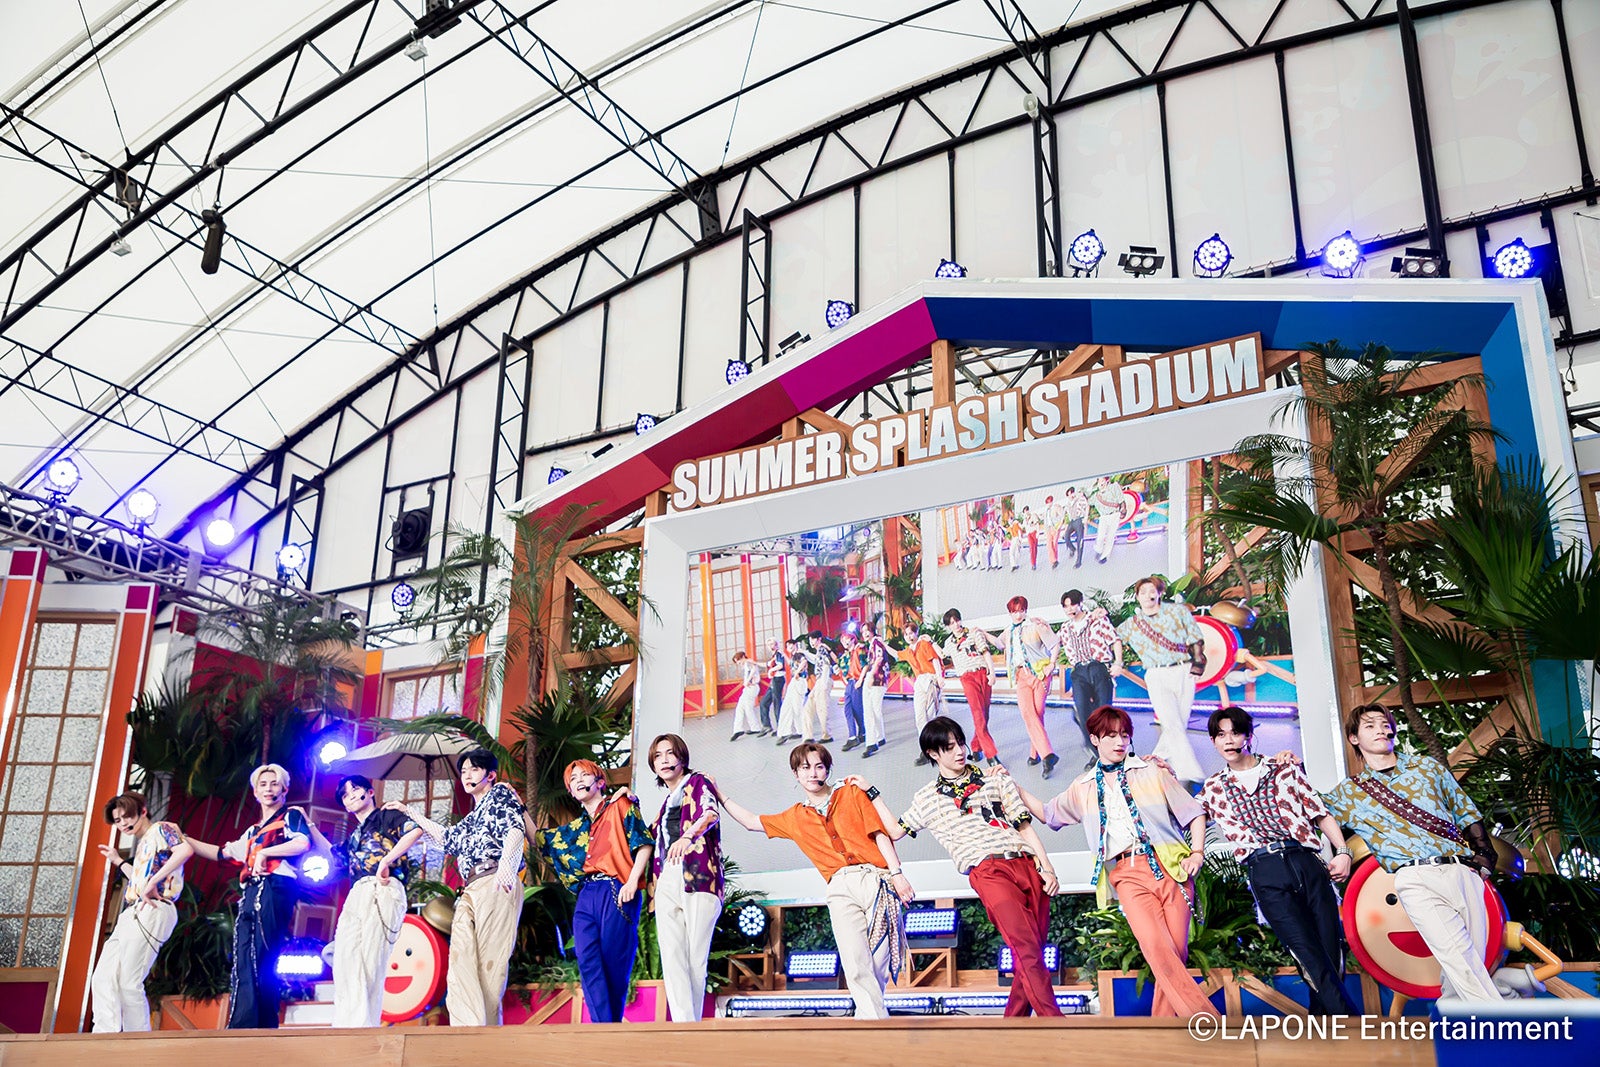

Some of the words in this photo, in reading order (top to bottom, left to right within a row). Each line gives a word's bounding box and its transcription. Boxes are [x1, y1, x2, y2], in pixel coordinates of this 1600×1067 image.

[673, 433, 843, 509] SUMMER
[852, 395, 1019, 472] SPLASH
[1030, 337, 1260, 434] STADIUM
